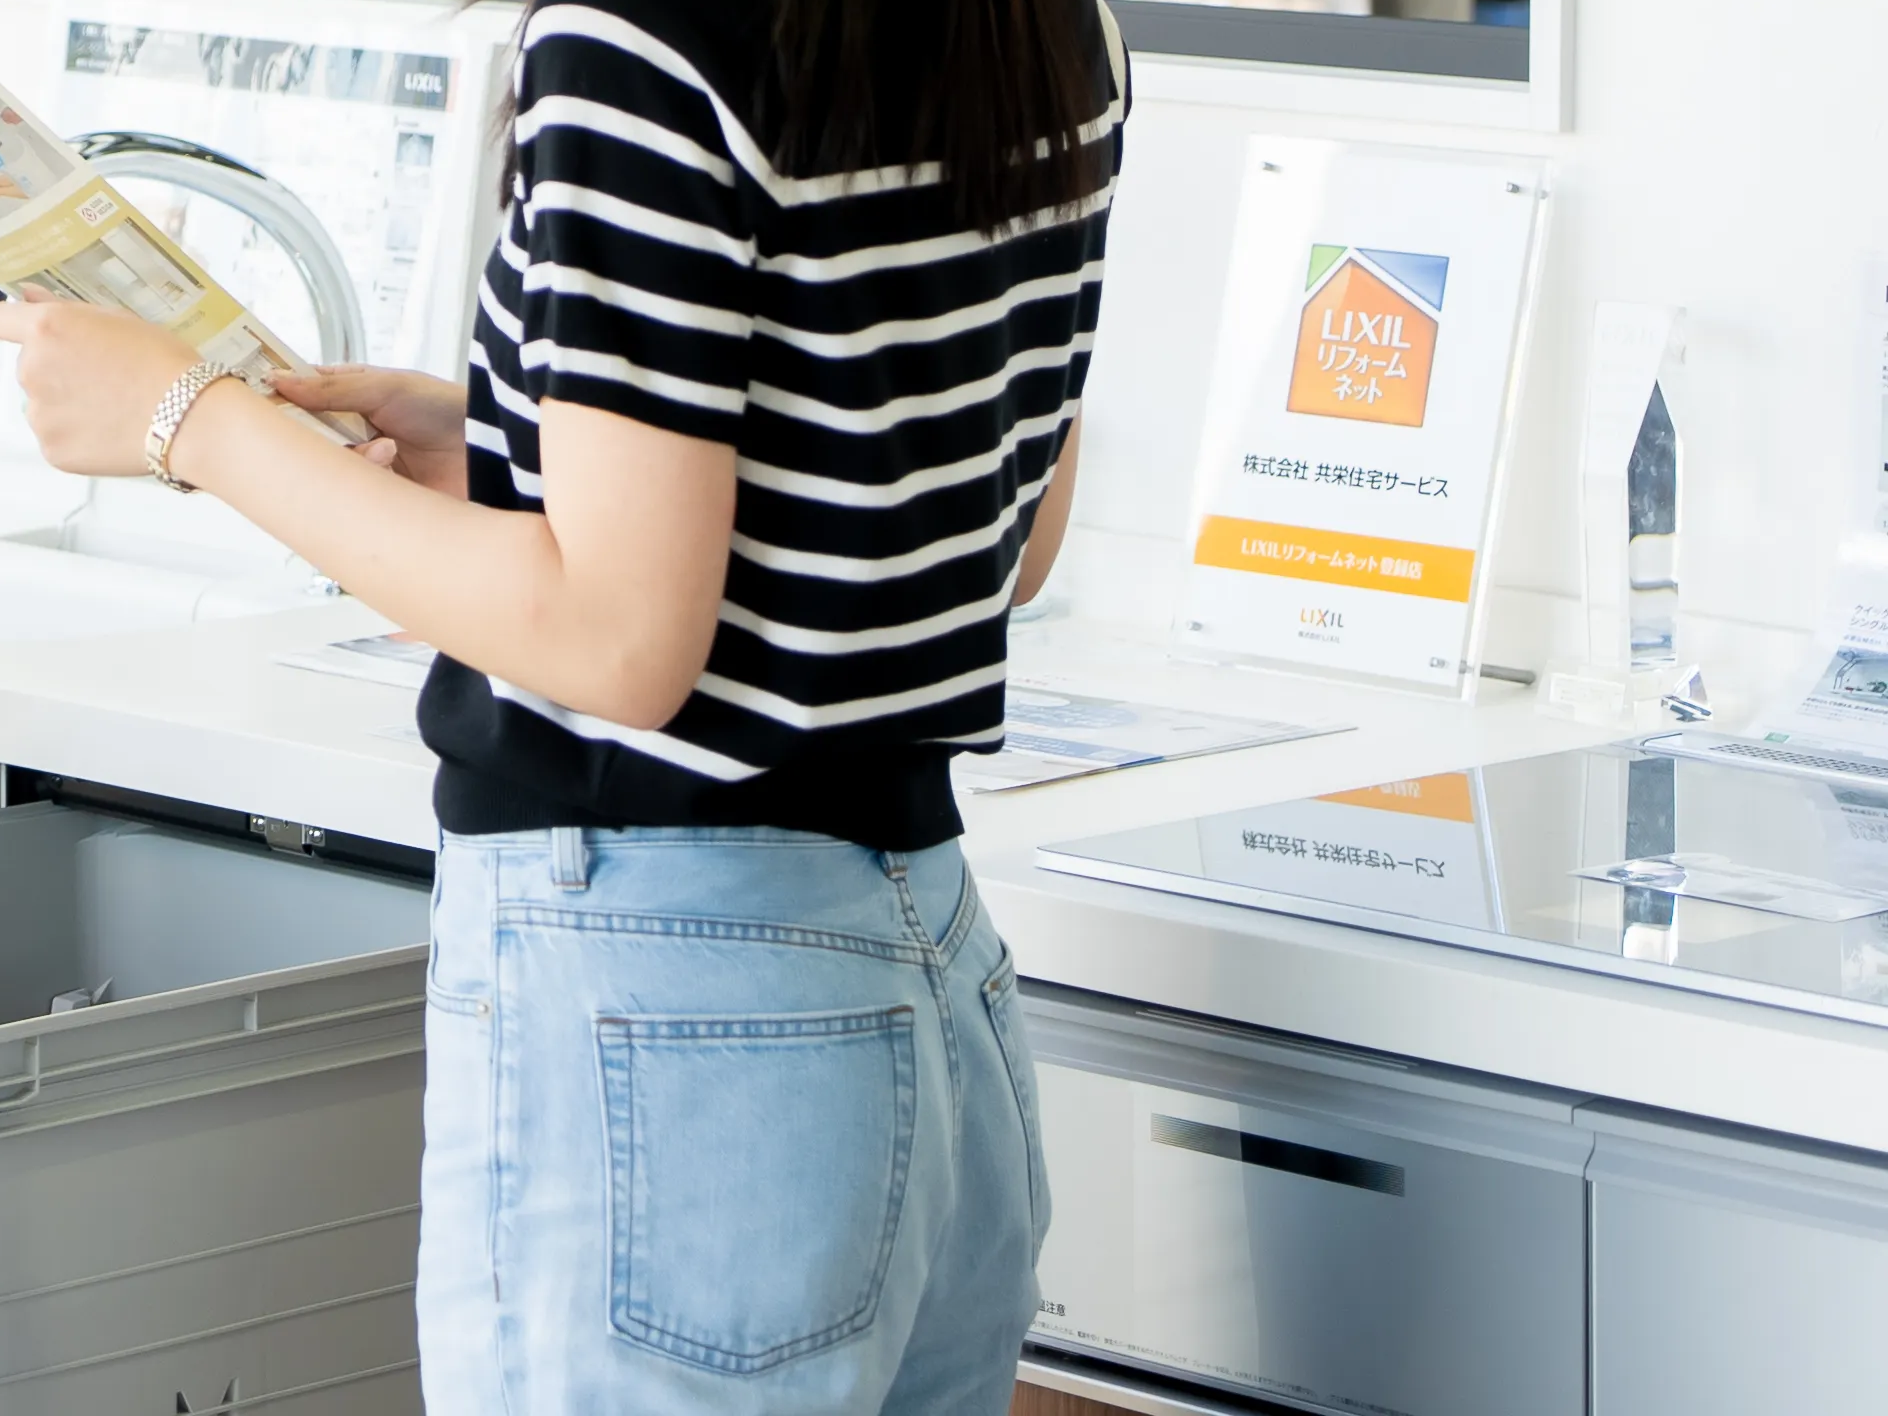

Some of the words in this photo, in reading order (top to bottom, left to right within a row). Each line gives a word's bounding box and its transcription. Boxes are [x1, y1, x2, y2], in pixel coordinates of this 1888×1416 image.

[404, 72, 442, 93] LIXIL
[1321, 308, 1412, 349] LIXIL
[1317, 343, 1408, 378] リフォーム
[1332, 374, 1383, 404] ネット
[1243, 453, 1309, 480] 株式会社
[1314, 462, 1449, 498] 共栄住宅サービス
[1299, 607, 1344, 628] LIXIL
